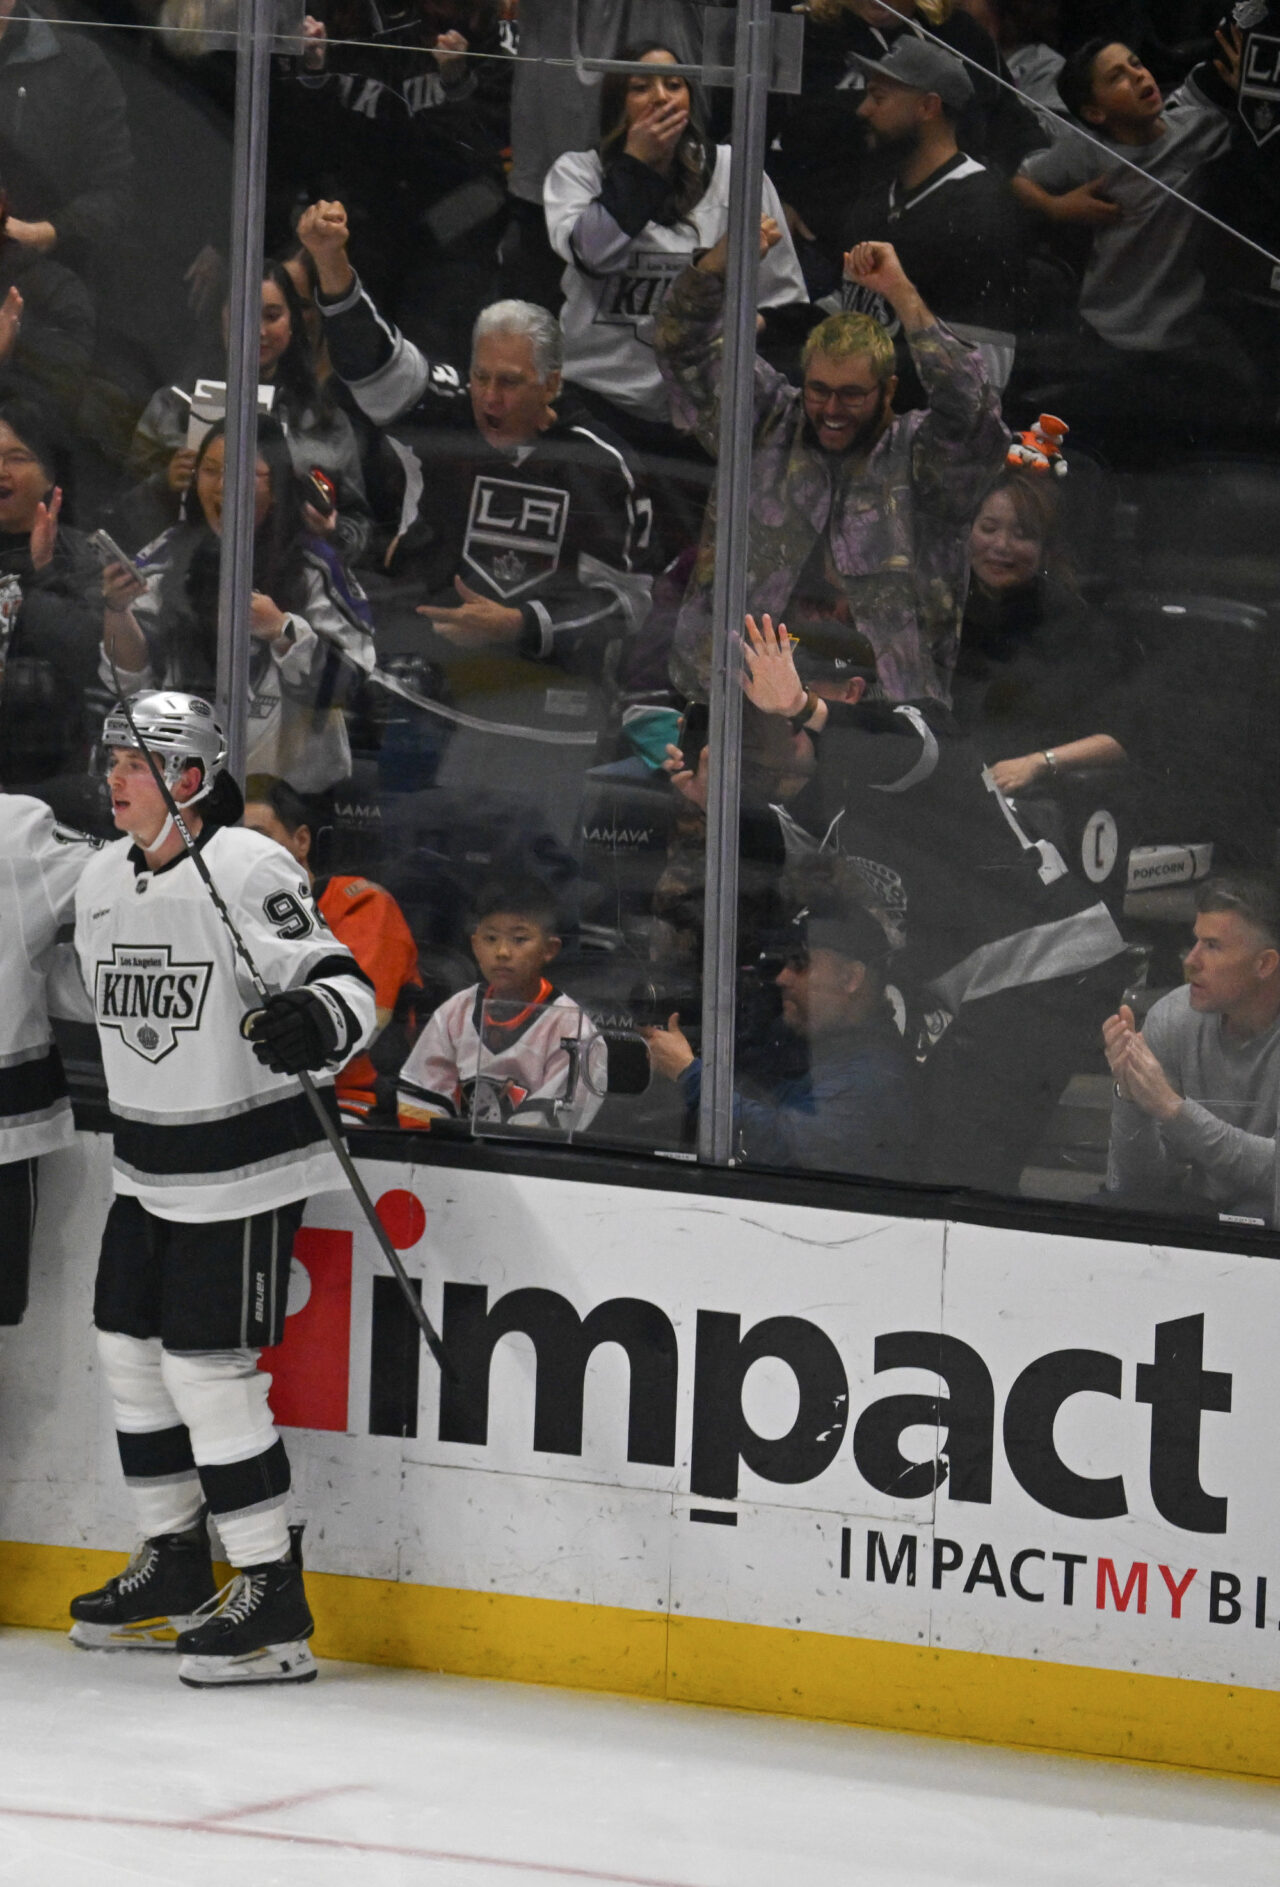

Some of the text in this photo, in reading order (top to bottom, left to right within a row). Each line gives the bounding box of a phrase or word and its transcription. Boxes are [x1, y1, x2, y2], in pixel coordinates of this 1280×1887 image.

[477, 489, 561, 537] LA
[1132, 861, 1185, 881] POPCORN
[102, 973, 198, 1019] KINGS
[369, 1188, 1233, 1534] impact
[840, 1526, 1280, 1632] IMPACTMYBI
